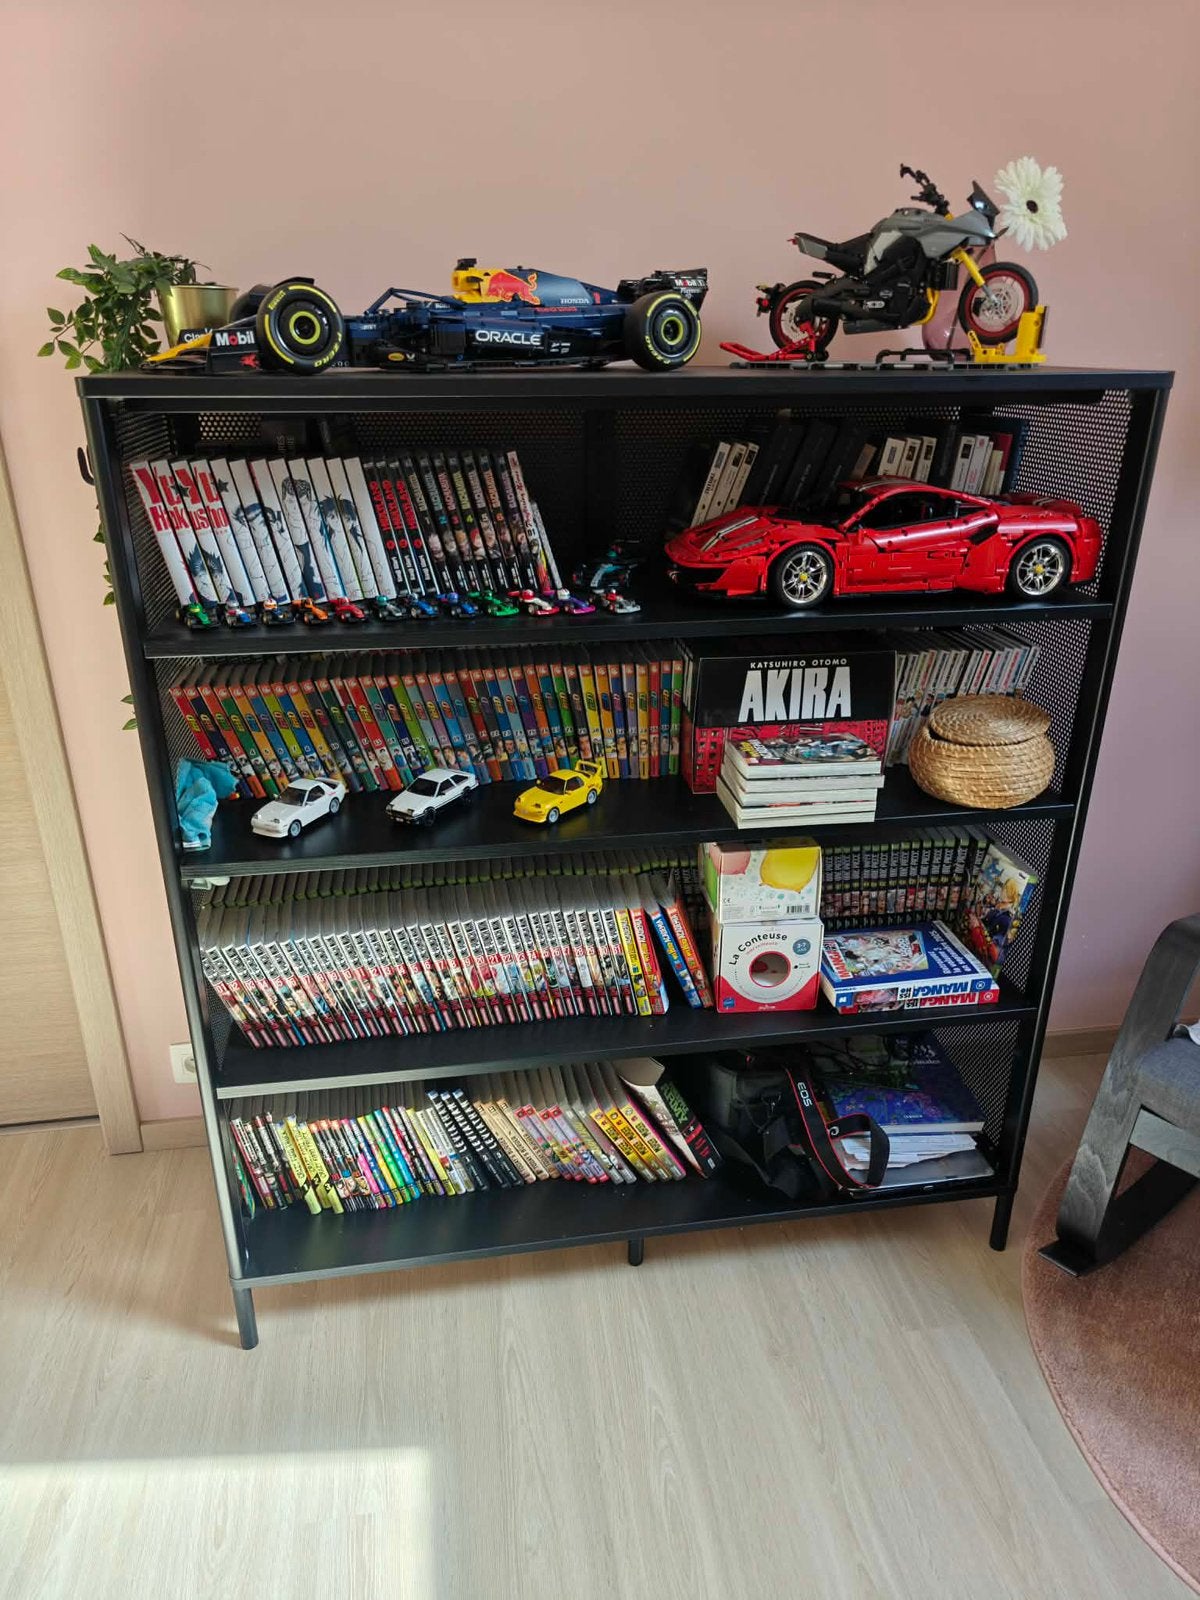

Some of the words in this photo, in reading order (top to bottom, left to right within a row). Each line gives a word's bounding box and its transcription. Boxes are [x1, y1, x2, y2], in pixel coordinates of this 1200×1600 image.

[215, 331, 255, 346] Mobil
[475, 330, 541, 346] ORACLE
[314, 344, 340, 368] ZERO
[466, 513, 474, 523] 4
[480, 513, 488, 522] 5
[750, 660, 807, 669] KATSUHIRO
[811, 658, 848, 666] OTOMO
[738, 666, 852, 723] AKIRA
[634, 917, 648, 943] ACADEMIA
[655, 918, 672, 943] ACADEMIA
[670, 913, 686, 939] ACADEMIA
[729, 954, 740, 966] La
[738, 932, 788, 952] Conteuse
[940, 942, 966, 967] septembre
[938, 950, 957, 968] volume
[963, 964, 972, 972] en
[912, 981, 969, 998] MANGA
[905, 999, 918, 1008] ISS
[919, 992, 976, 1007] MANGA
[658, 1082, 689, 1125] ARMY
[797, 1082, 813, 1107] EOS
[433, 1100, 468, 1153] LEVIATHAN
[446, 1101, 485, 1153] LEVIATHAN
[460, 1099, 498, 1150] LEVIATHAN
[510, 1135, 527, 1153] BURGER
[465, 1155, 471, 1163] 1
[481, 1153, 489, 1162] 2
[495, 1151, 502, 1159] 3
[302, 1165, 332, 1197] 3
[313, 1177, 320, 1185] 2
